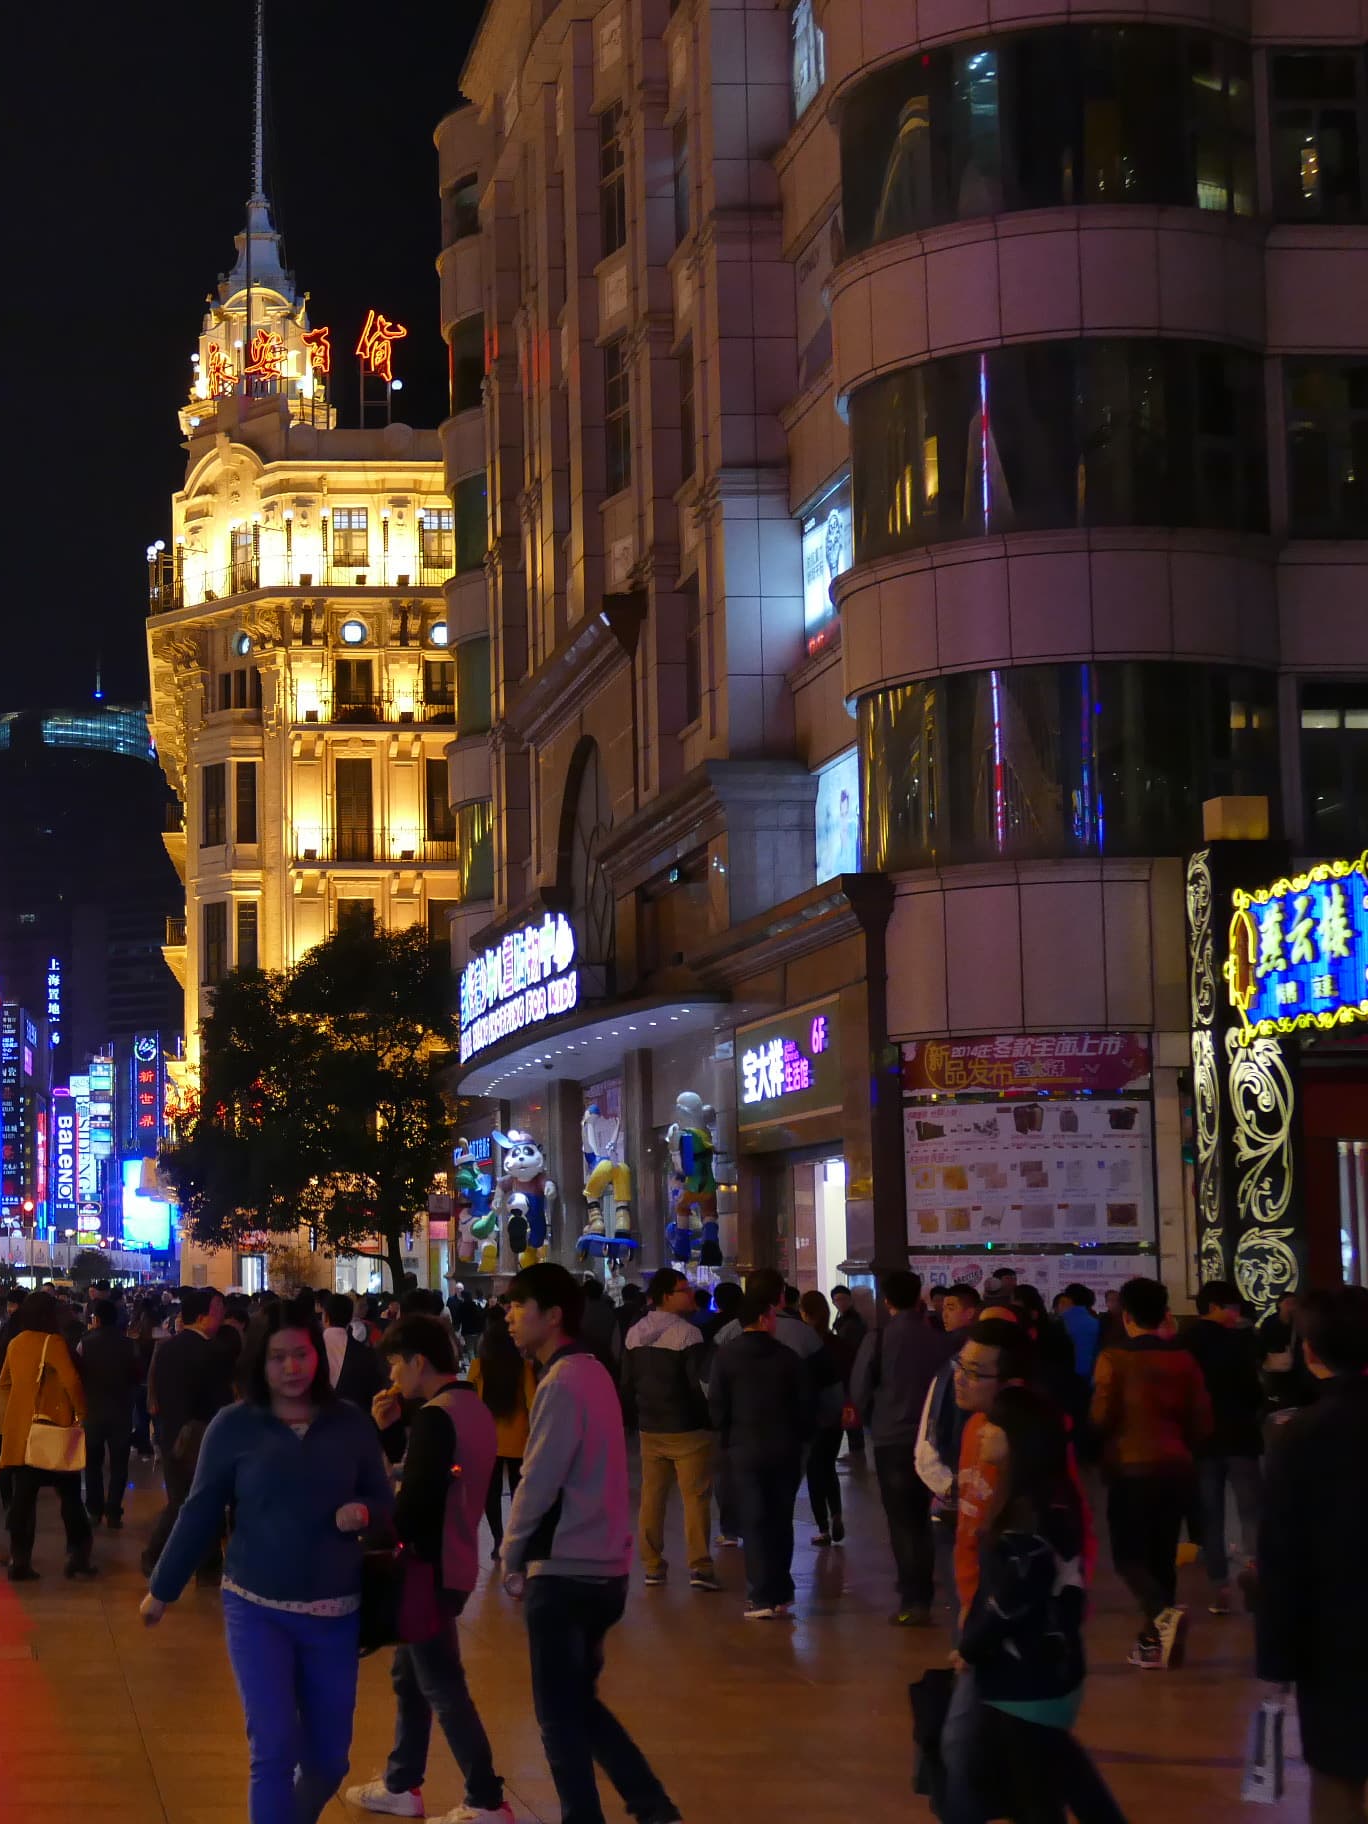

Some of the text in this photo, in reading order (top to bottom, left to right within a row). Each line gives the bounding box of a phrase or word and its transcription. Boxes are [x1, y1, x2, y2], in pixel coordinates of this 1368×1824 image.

[525, 986, 548, 1026] FOR
[547, 971, 577, 1016] KIDS
[812, 1017, 825, 1054] 6F
[139, 1070, 155, 1126] 新世界
[742, 1038, 784, 1104] 宝大祥
